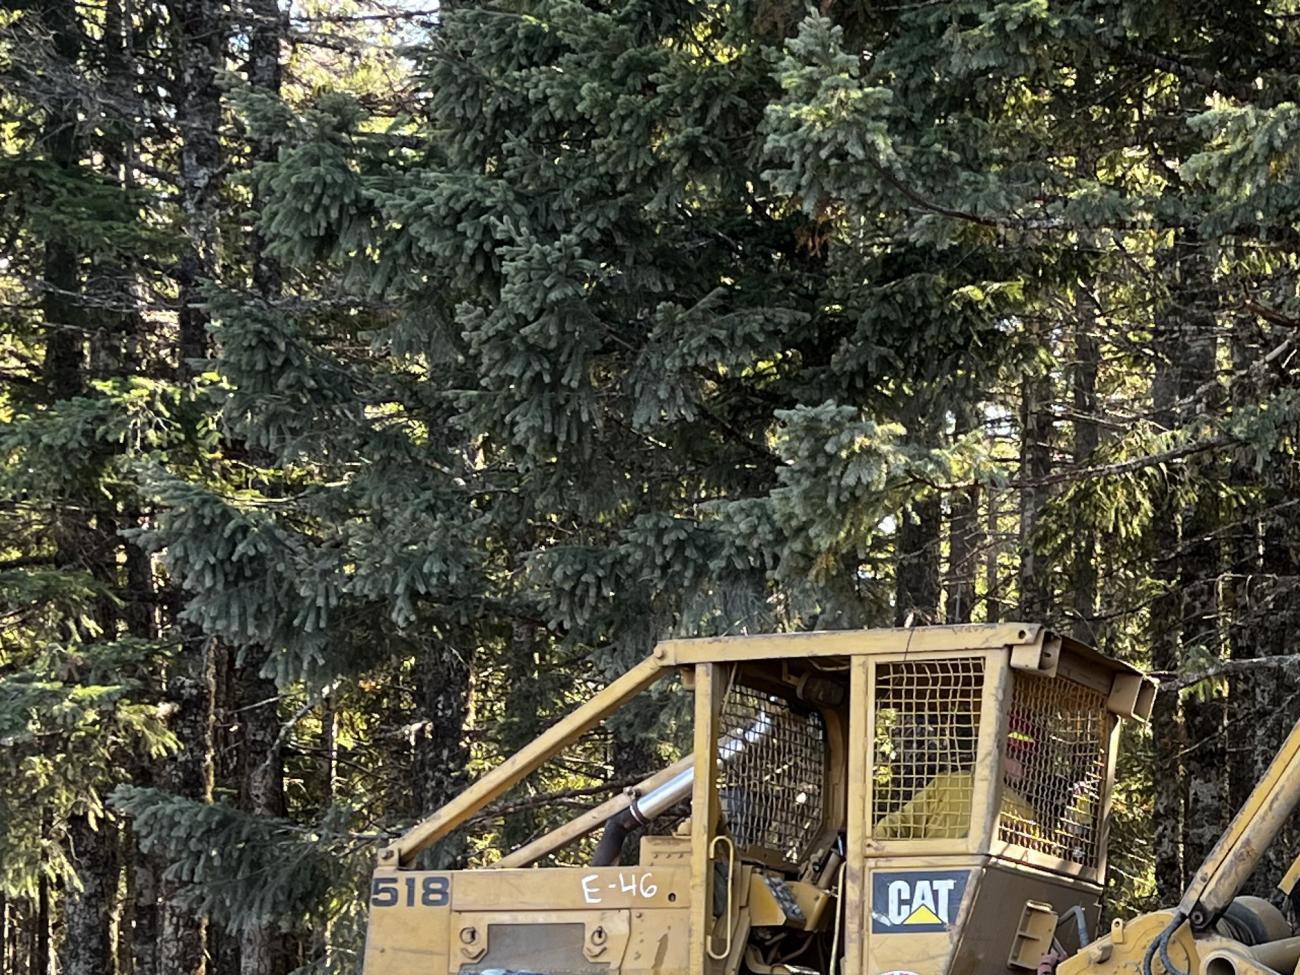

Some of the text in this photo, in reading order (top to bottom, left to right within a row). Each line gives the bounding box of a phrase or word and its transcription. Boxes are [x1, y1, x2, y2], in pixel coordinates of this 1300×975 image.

[371, 876, 450, 908] 518
[581, 871, 658, 904] E-46
[888, 879, 955, 925] CAT
